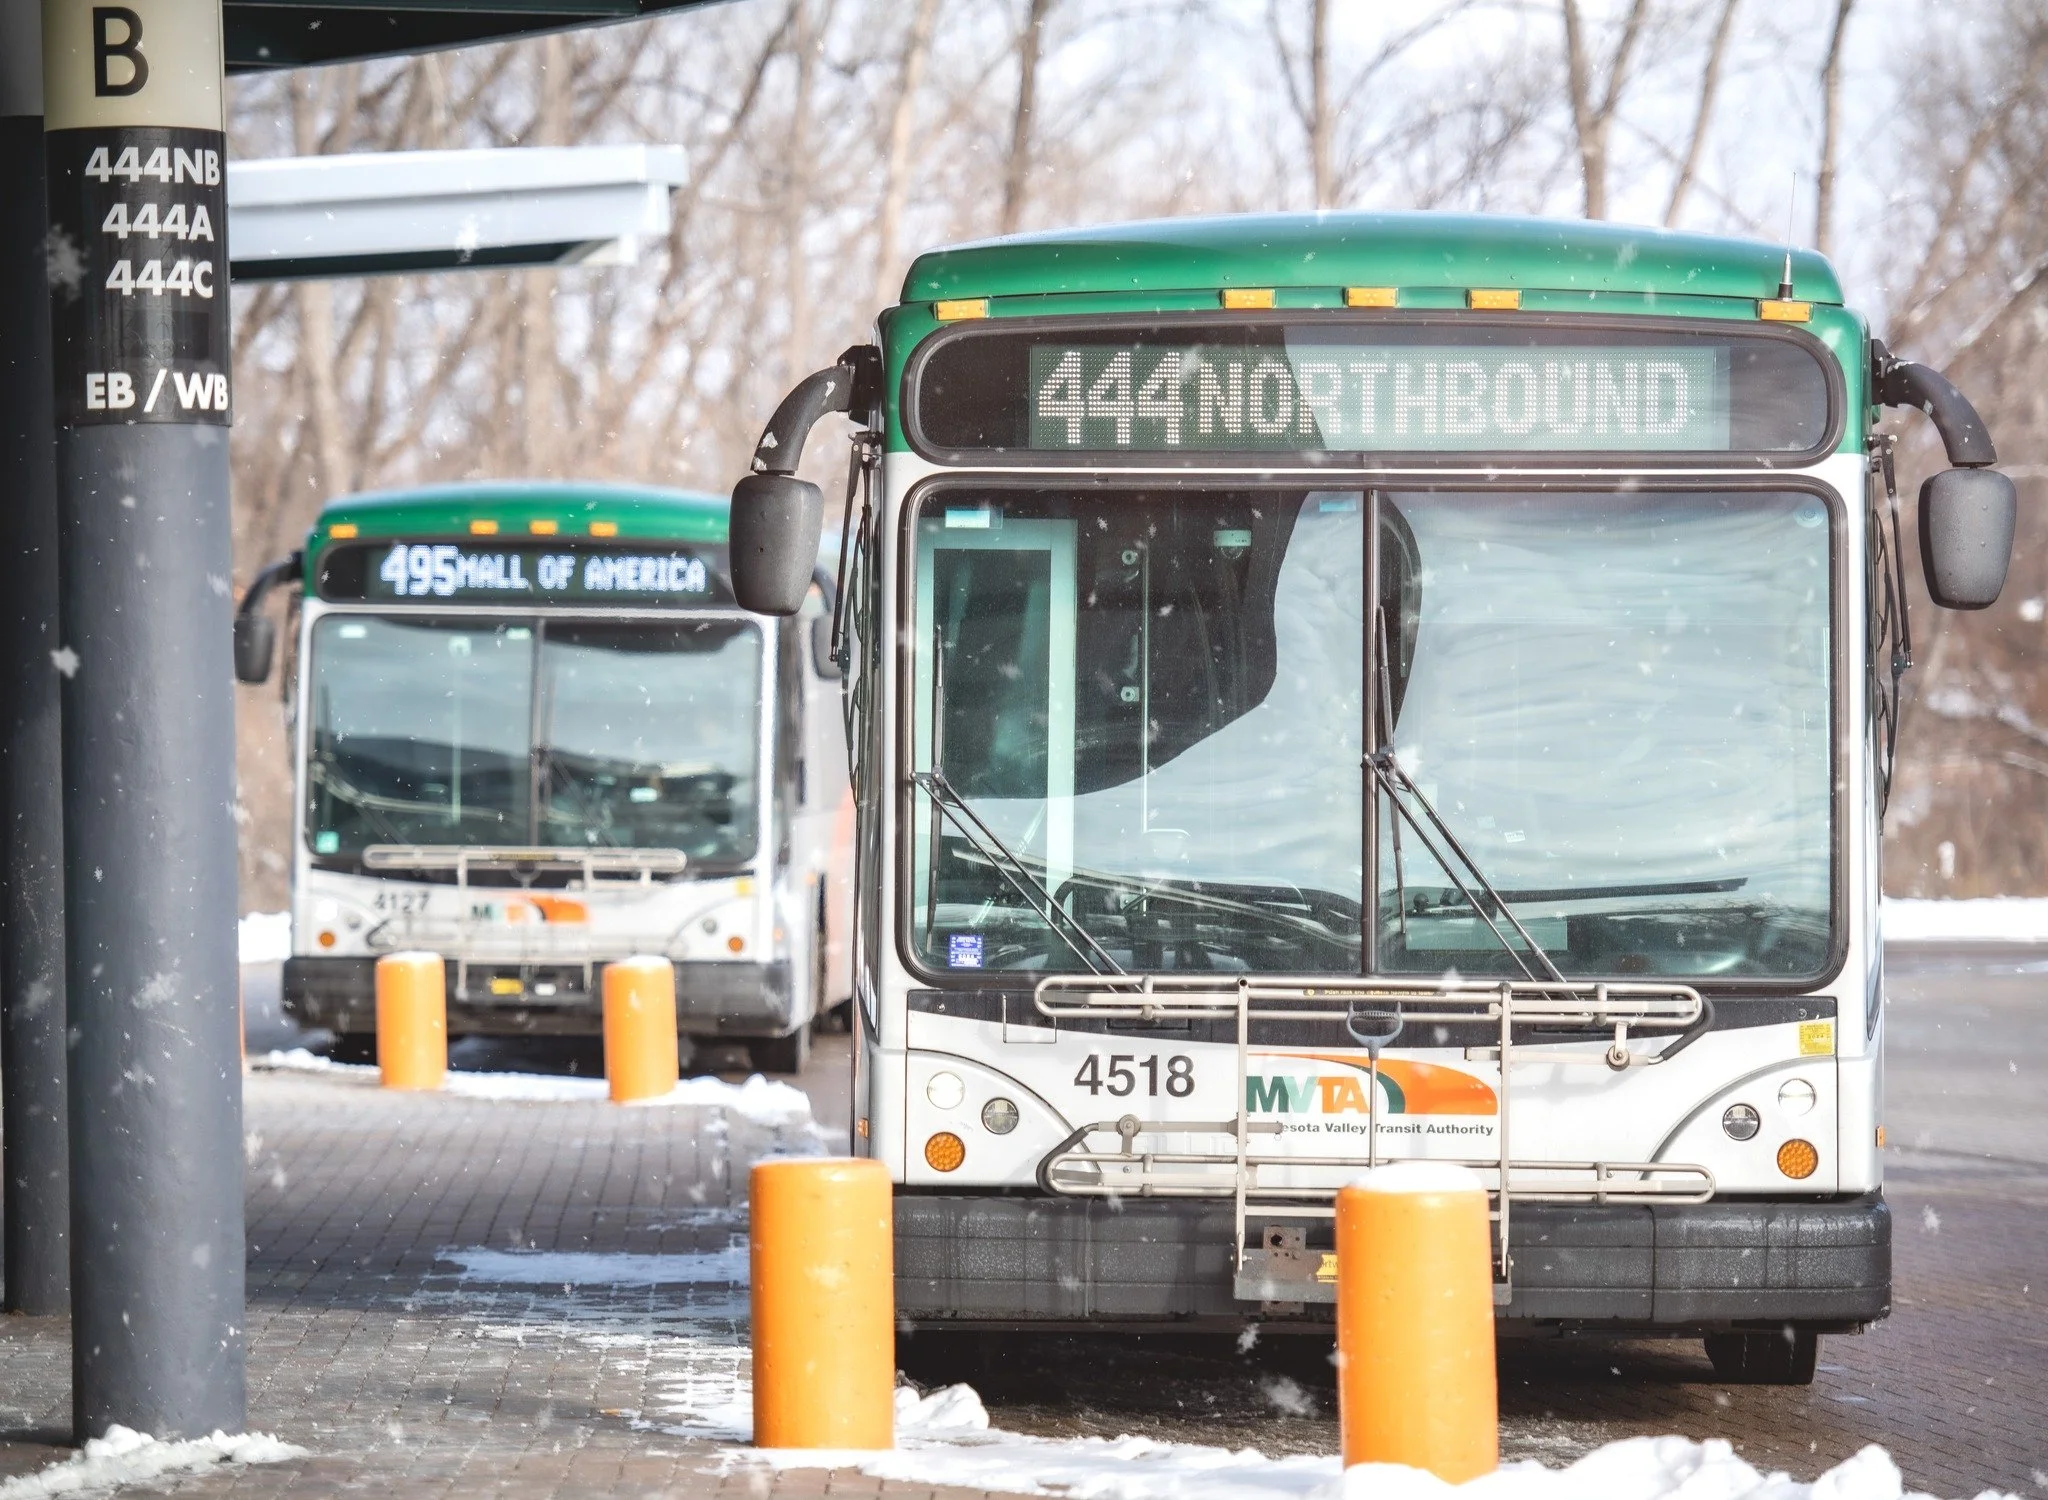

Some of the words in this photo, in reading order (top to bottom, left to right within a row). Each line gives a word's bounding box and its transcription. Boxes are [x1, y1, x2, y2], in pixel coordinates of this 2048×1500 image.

[92, 6, 149, 97] B
[85, 146, 221, 186] 444NB
[101, 203, 215, 242] 444A
[105, 259, 214, 299] 444C
[86, 372, 136, 411] EB
[173, 371, 229, 411] WB
[1037, 351, 1181, 445] 444
[1199, 361, 1688, 435] NORTHBOUND
[380, 544, 459, 596] 495
[458, 554, 530, 589] MALL
[537, 554, 575, 590] OF
[584, 555, 706, 592] AMERICA
[1073, 1054, 1196, 1098] 4518
[1246, 1075, 1371, 1114] MVTA
[1325, 1123, 1367, 1135] Valley
[1374, 1122, 1422, 1134] Transit
[1426, 1123, 1494, 1136] Authority
